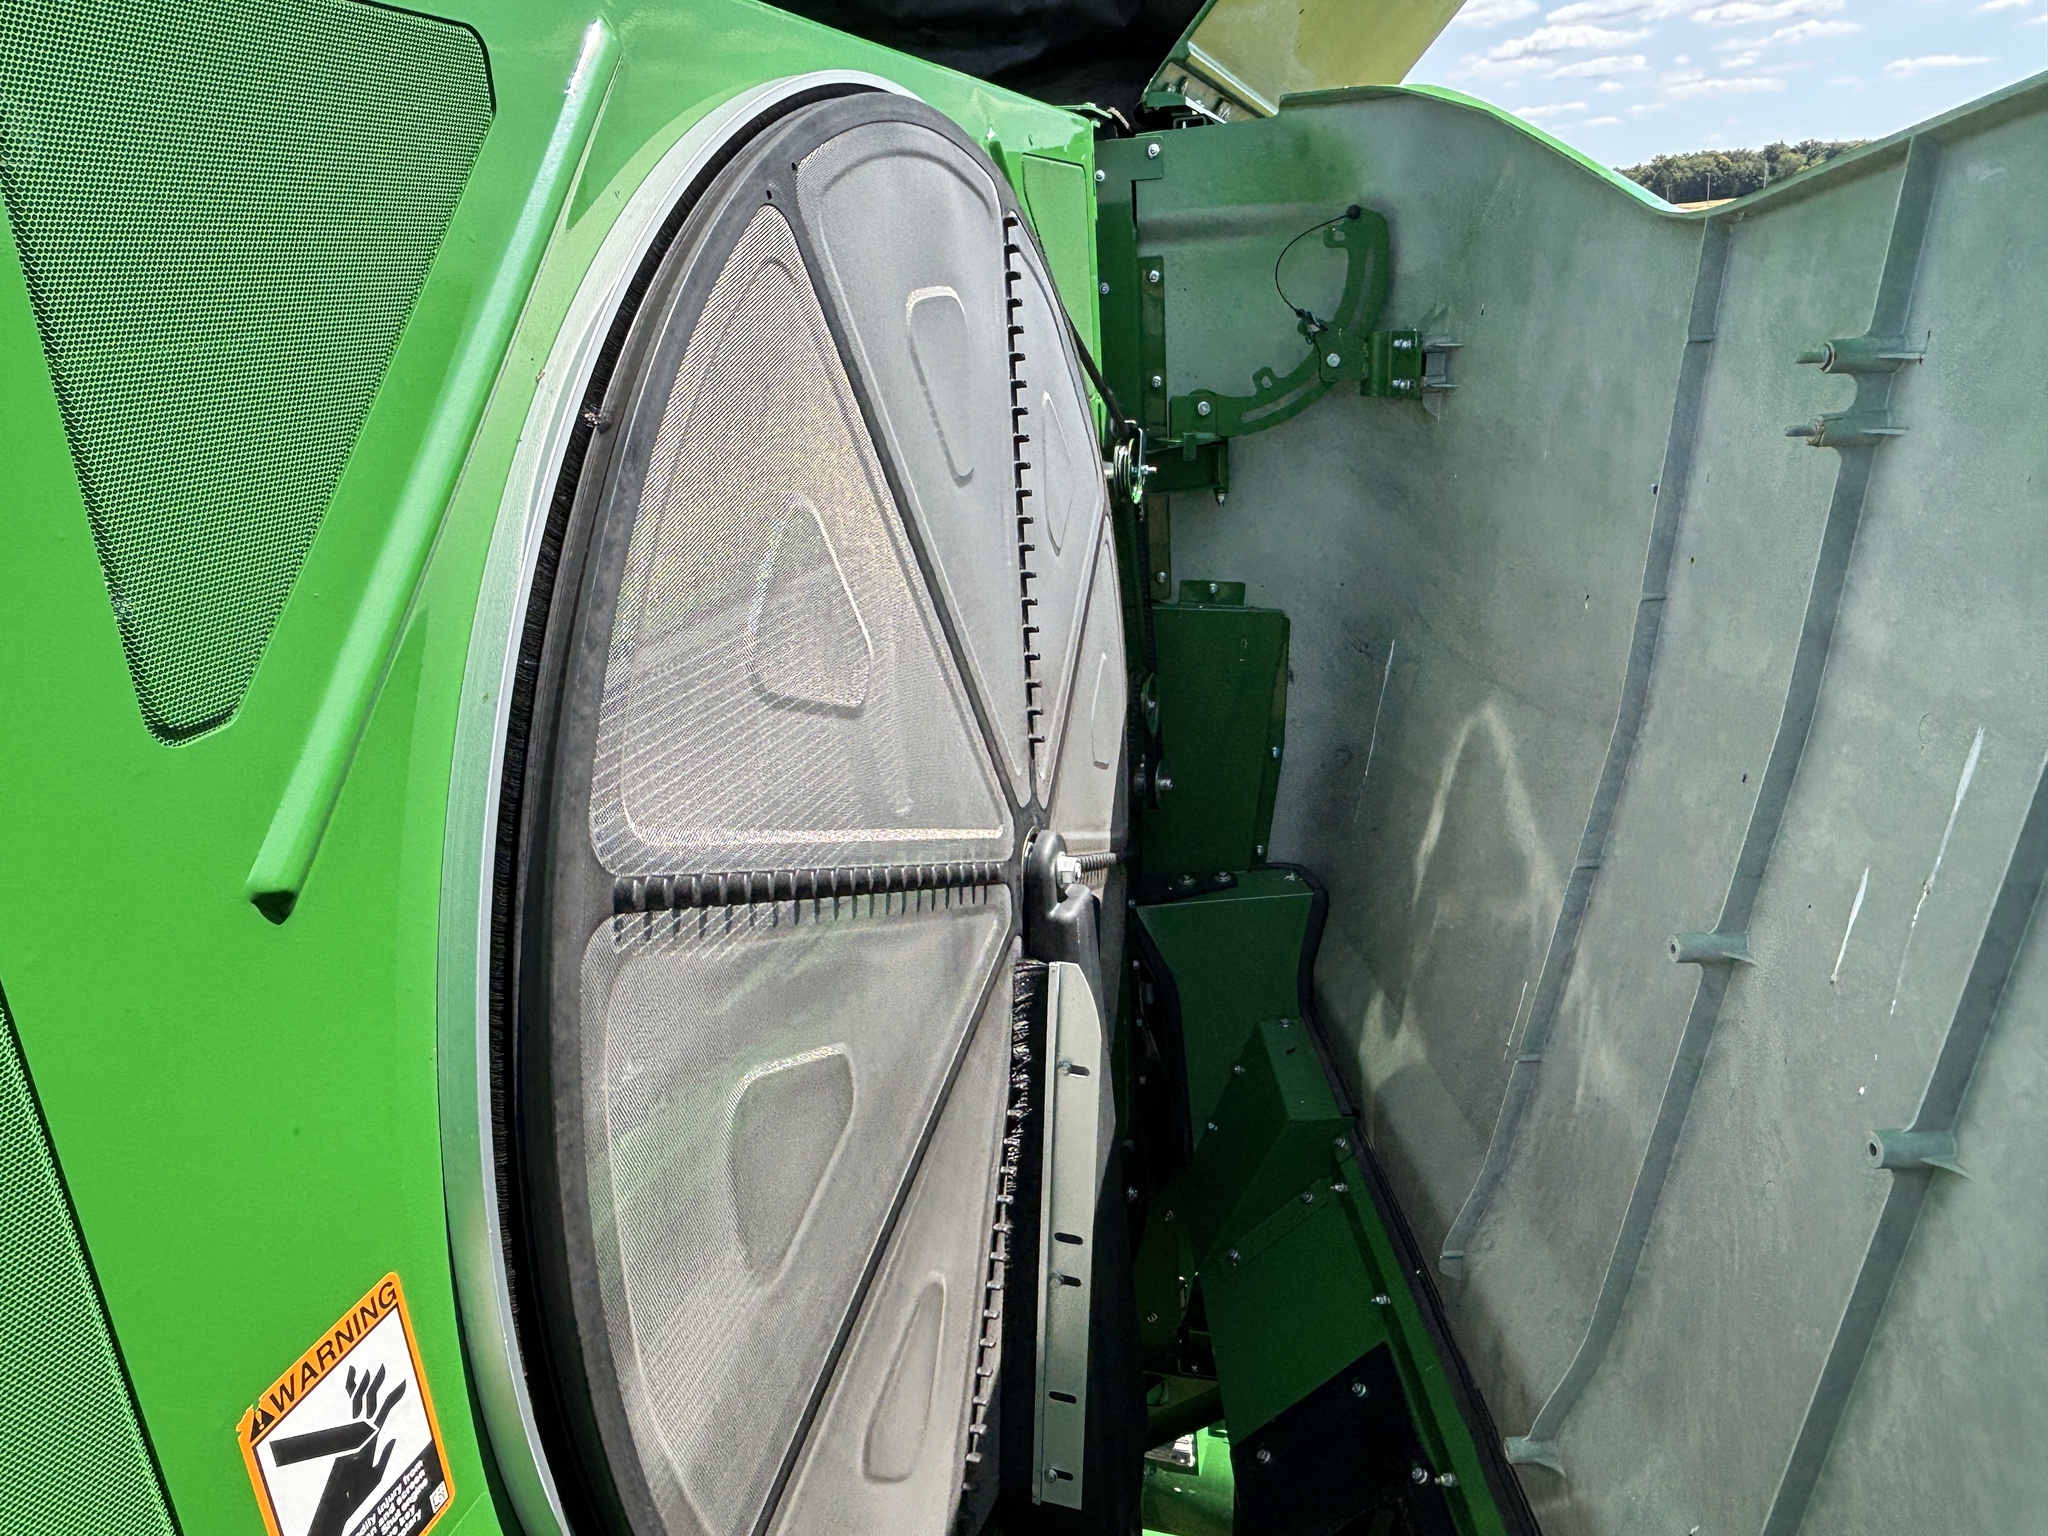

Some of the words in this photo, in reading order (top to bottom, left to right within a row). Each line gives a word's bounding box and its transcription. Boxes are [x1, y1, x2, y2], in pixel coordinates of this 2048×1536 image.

[269, 1281, 397, 1413] WARNING
[377, 1483, 402, 1515] injury
[402, 1460, 424, 1485] from
[378, 1502, 396, 1527] and
[396, 1469, 426, 1506] screen
[381, 1508, 402, 1536] Shut
[400, 1477, 428, 1512] engine
[399, 1504, 415, 1527] key
